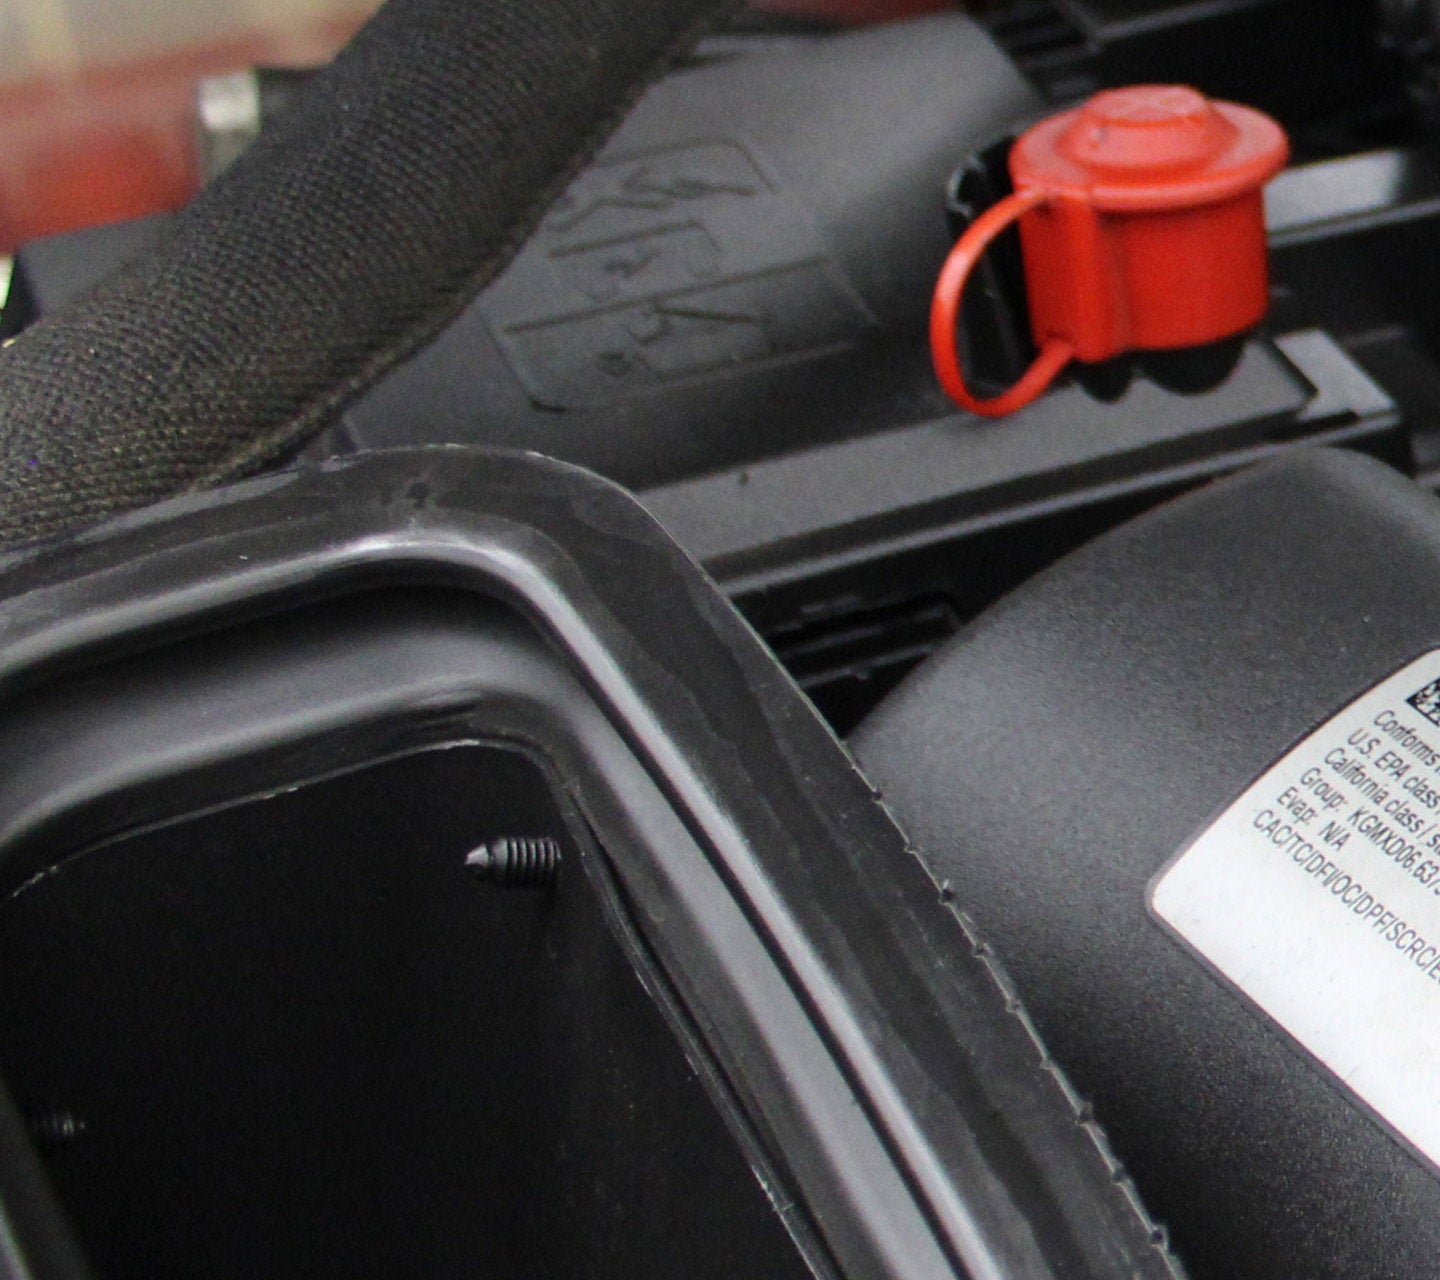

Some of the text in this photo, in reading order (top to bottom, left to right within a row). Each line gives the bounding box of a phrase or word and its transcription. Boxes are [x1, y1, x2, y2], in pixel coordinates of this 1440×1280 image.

[1347, 728, 1380, 758] U.S.
[1373, 750, 1410, 781] EPA
[1373, 710, 1440, 766] Conforms
[1299, 767, 1347, 811] Group:
[1324, 748, 1388, 804] California
[1383, 799, 1424, 833] class
[1276, 786, 1350, 851] Evap: N/A
